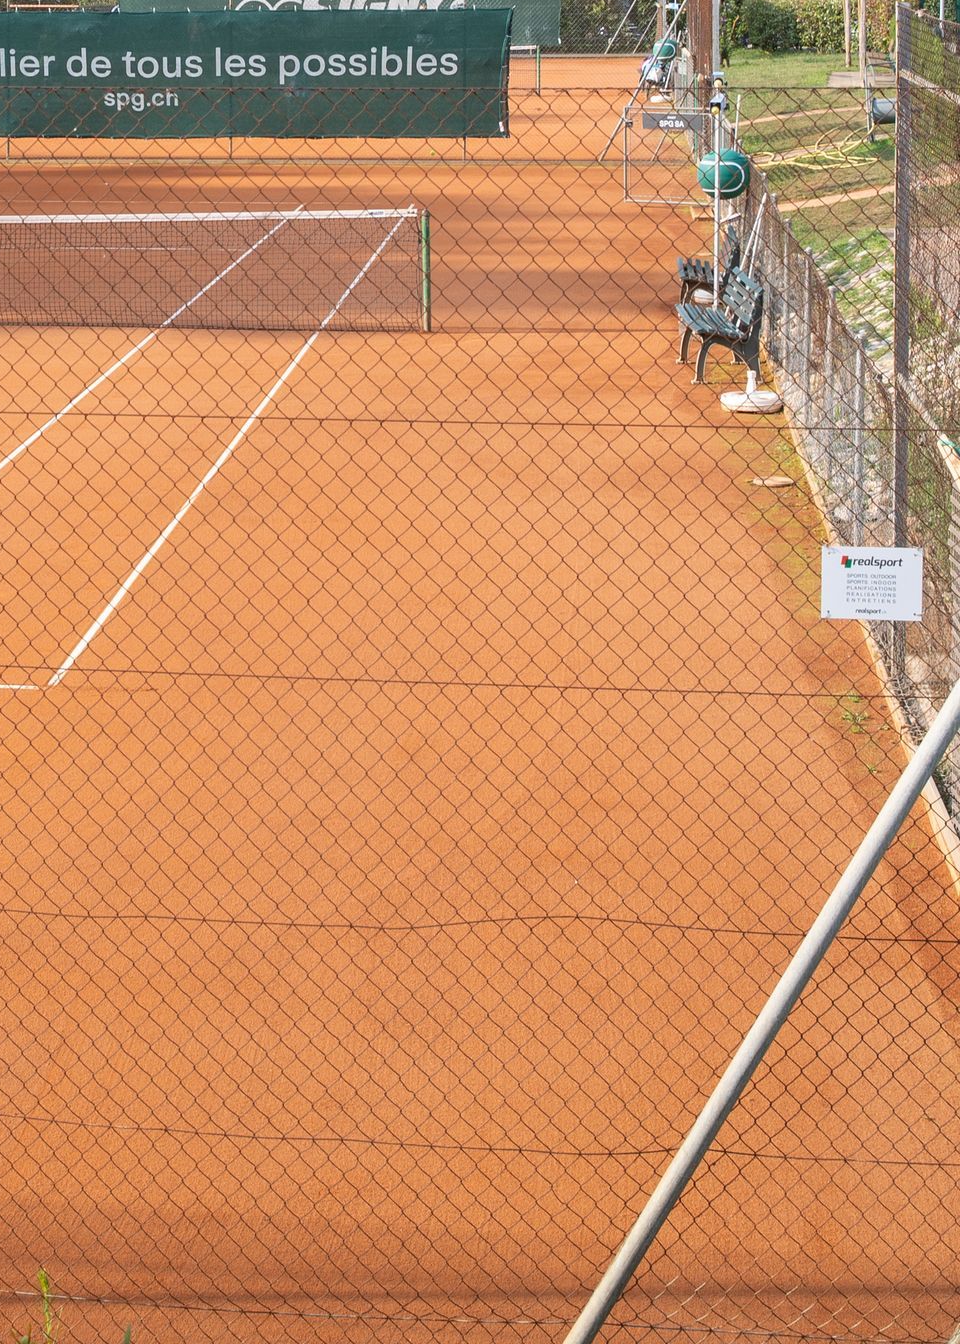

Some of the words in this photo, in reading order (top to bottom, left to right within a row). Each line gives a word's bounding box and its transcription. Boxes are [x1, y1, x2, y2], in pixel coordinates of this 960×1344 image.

[66, 47, 112, 78] de
[121, 50, 204, 79] tous
[214, 47, 267, 78] les
[279, 46, 459, 85] possibles
[103, 89, 180, 112] spg.ch
[852, 556, 903, 569] realsport
